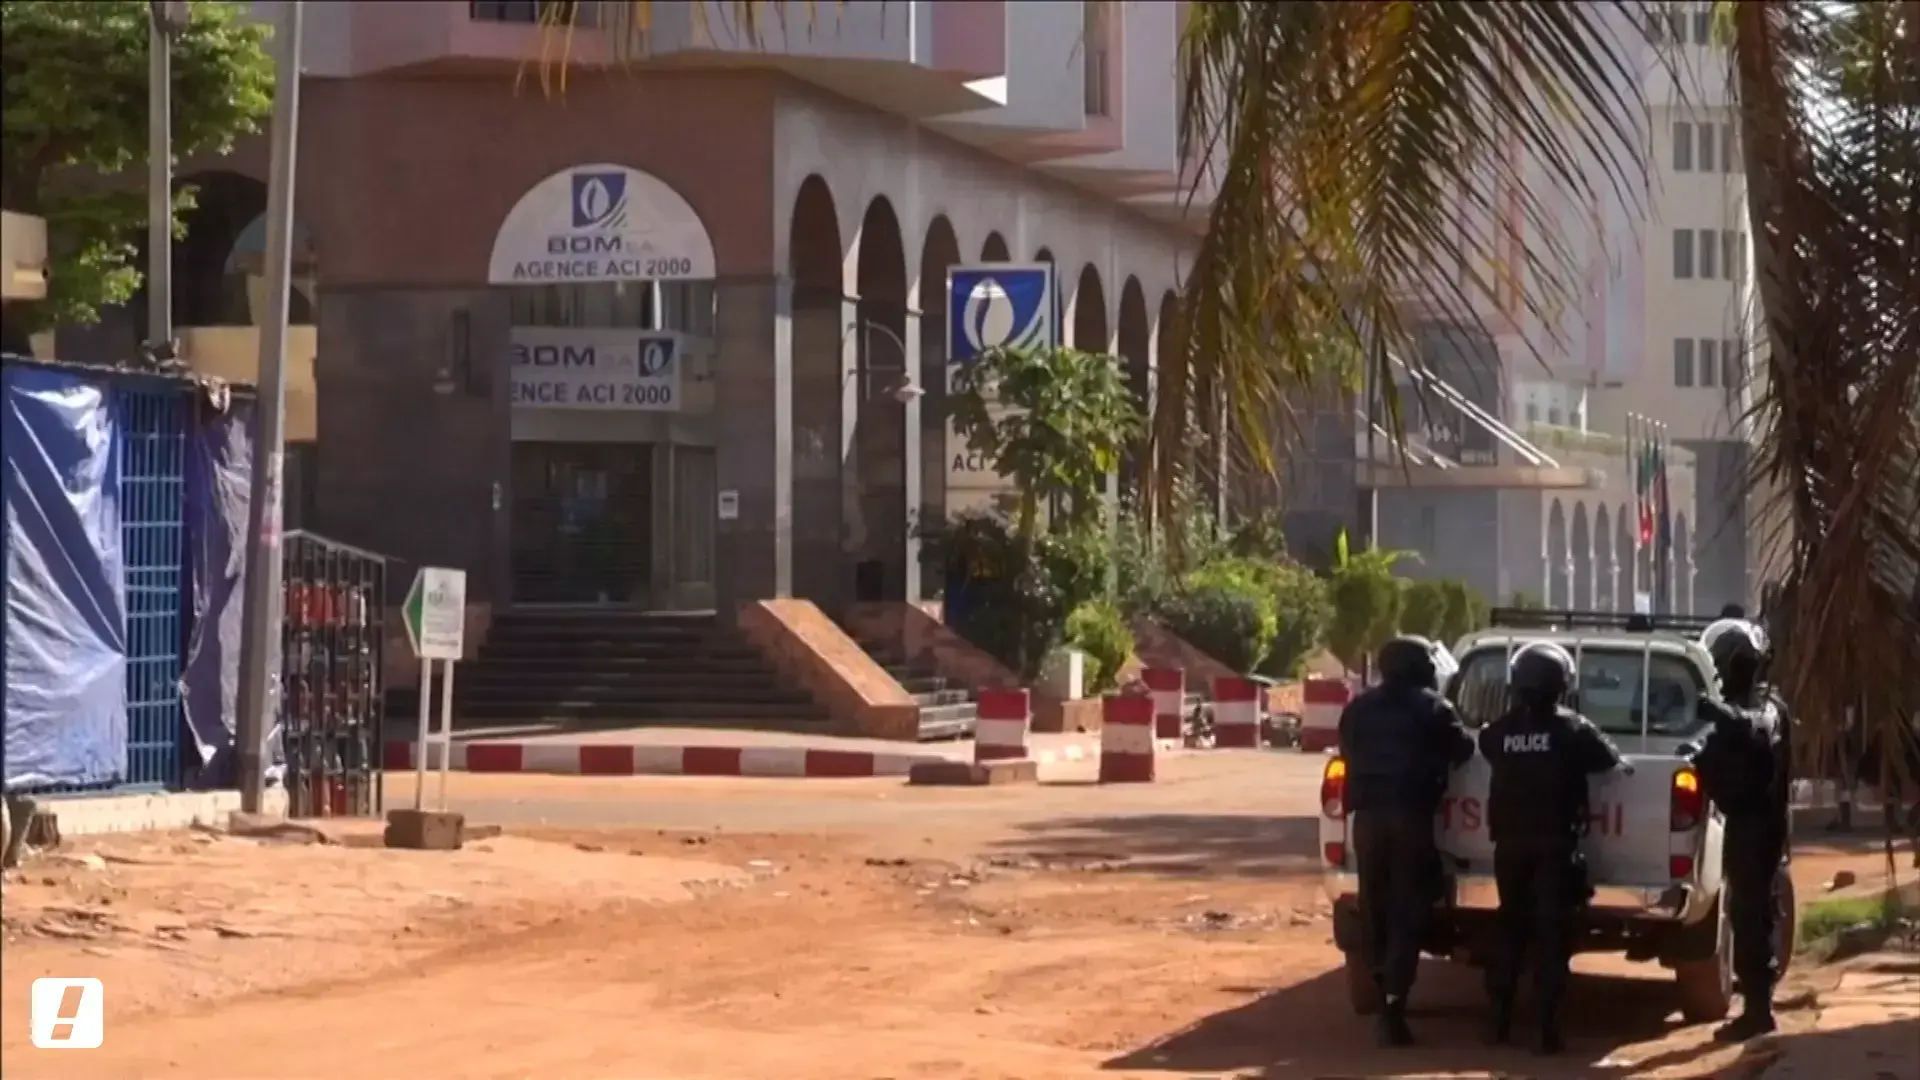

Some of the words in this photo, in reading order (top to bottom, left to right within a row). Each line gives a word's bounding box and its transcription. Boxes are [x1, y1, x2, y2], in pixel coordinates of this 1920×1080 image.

[547, 236, 621, 253] BDM
[512, 260, 598, 278] AGENCE
[604, 259, 641, 276] ACI
[645, 257, 692, 275] 2000
[577, 382, 615, 403] ACI
[622, 382, 672, 405] 2000
[951, 453, 985, 472] ACI
[1503, 732, 1551, 753] POLICE
